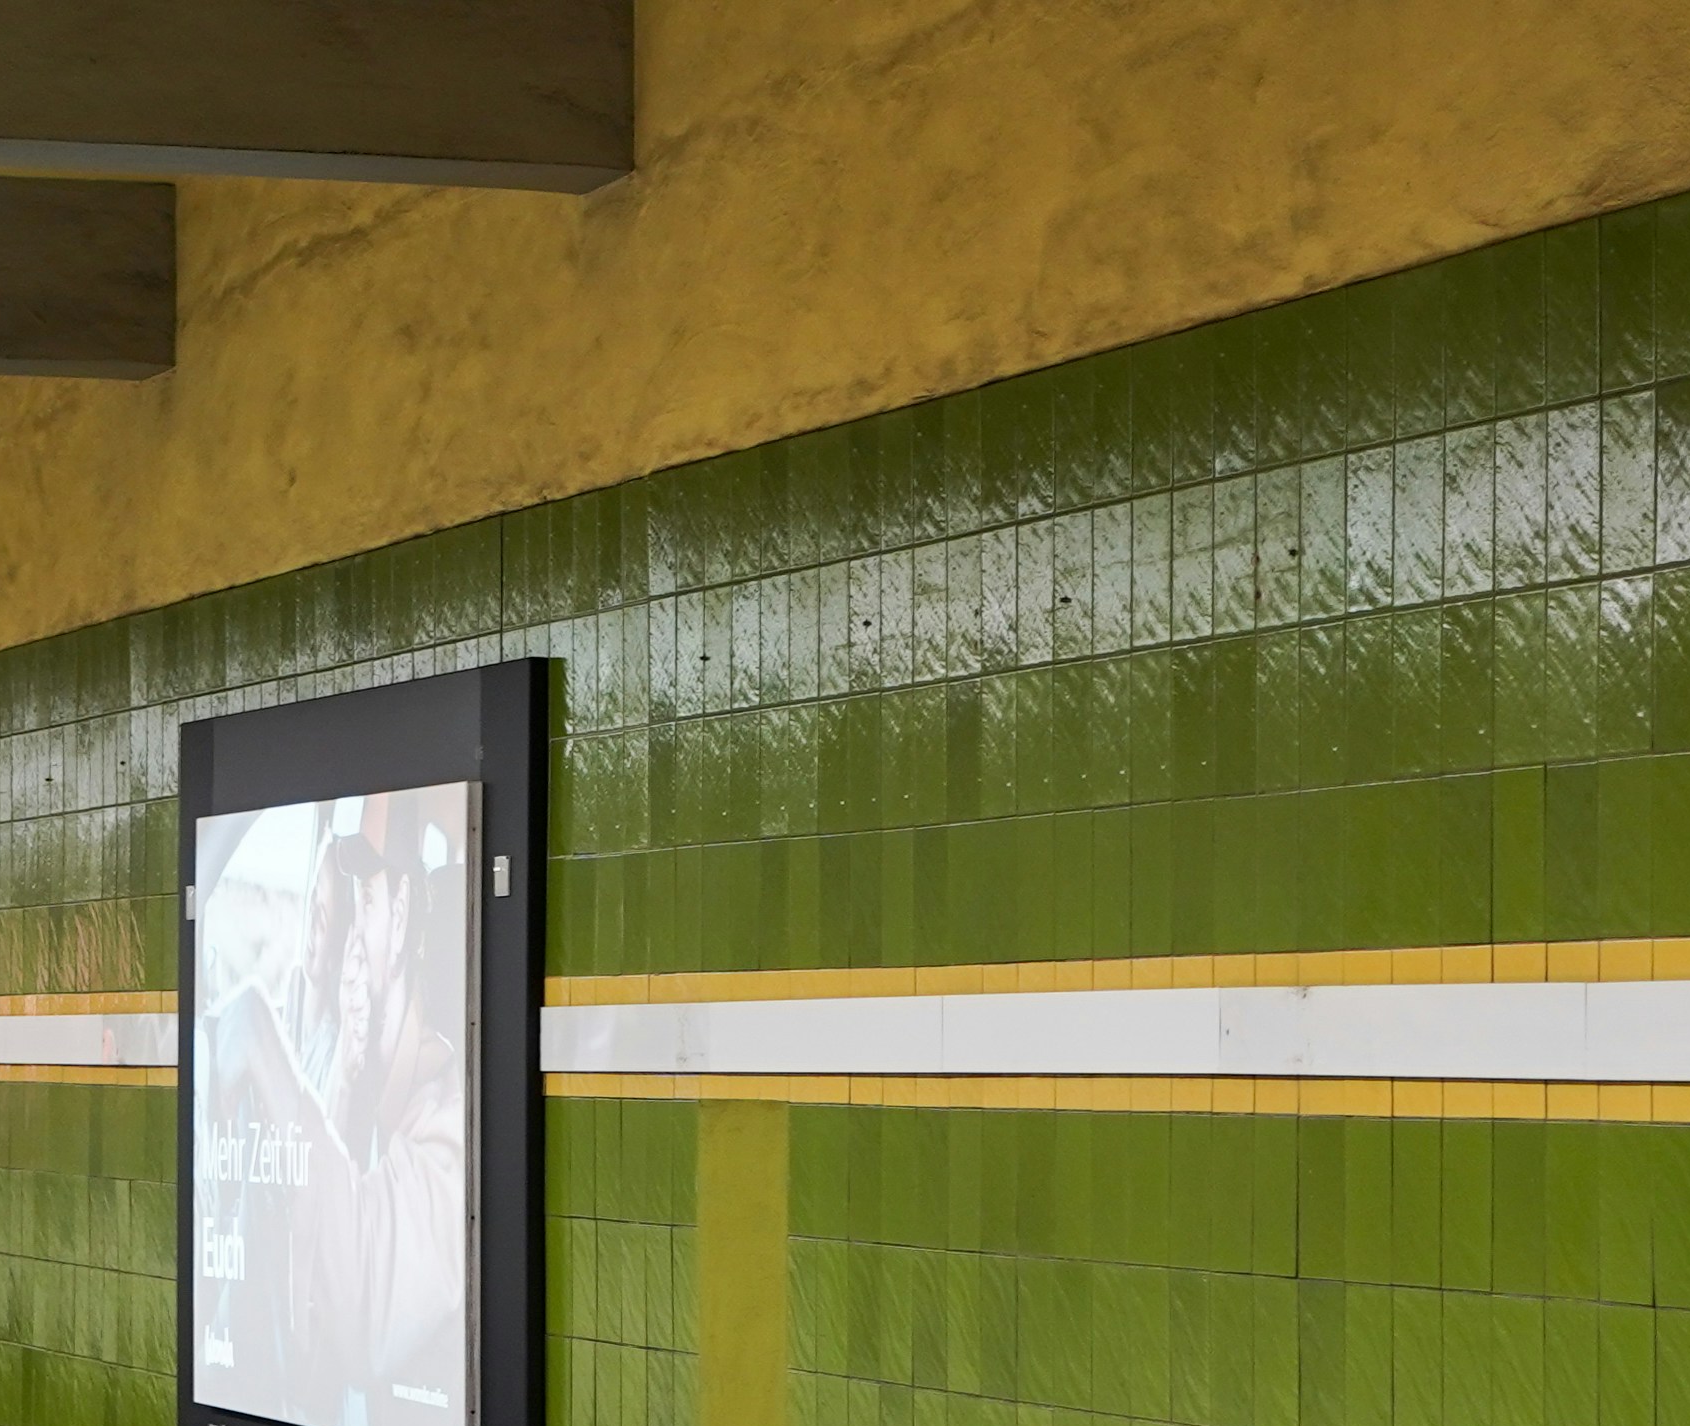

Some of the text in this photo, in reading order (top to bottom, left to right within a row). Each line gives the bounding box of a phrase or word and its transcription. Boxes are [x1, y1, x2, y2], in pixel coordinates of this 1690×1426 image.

[202, 1119, 313, 1187] Mehr Zeit für
[202, 1216, 246, 1281] Euch
